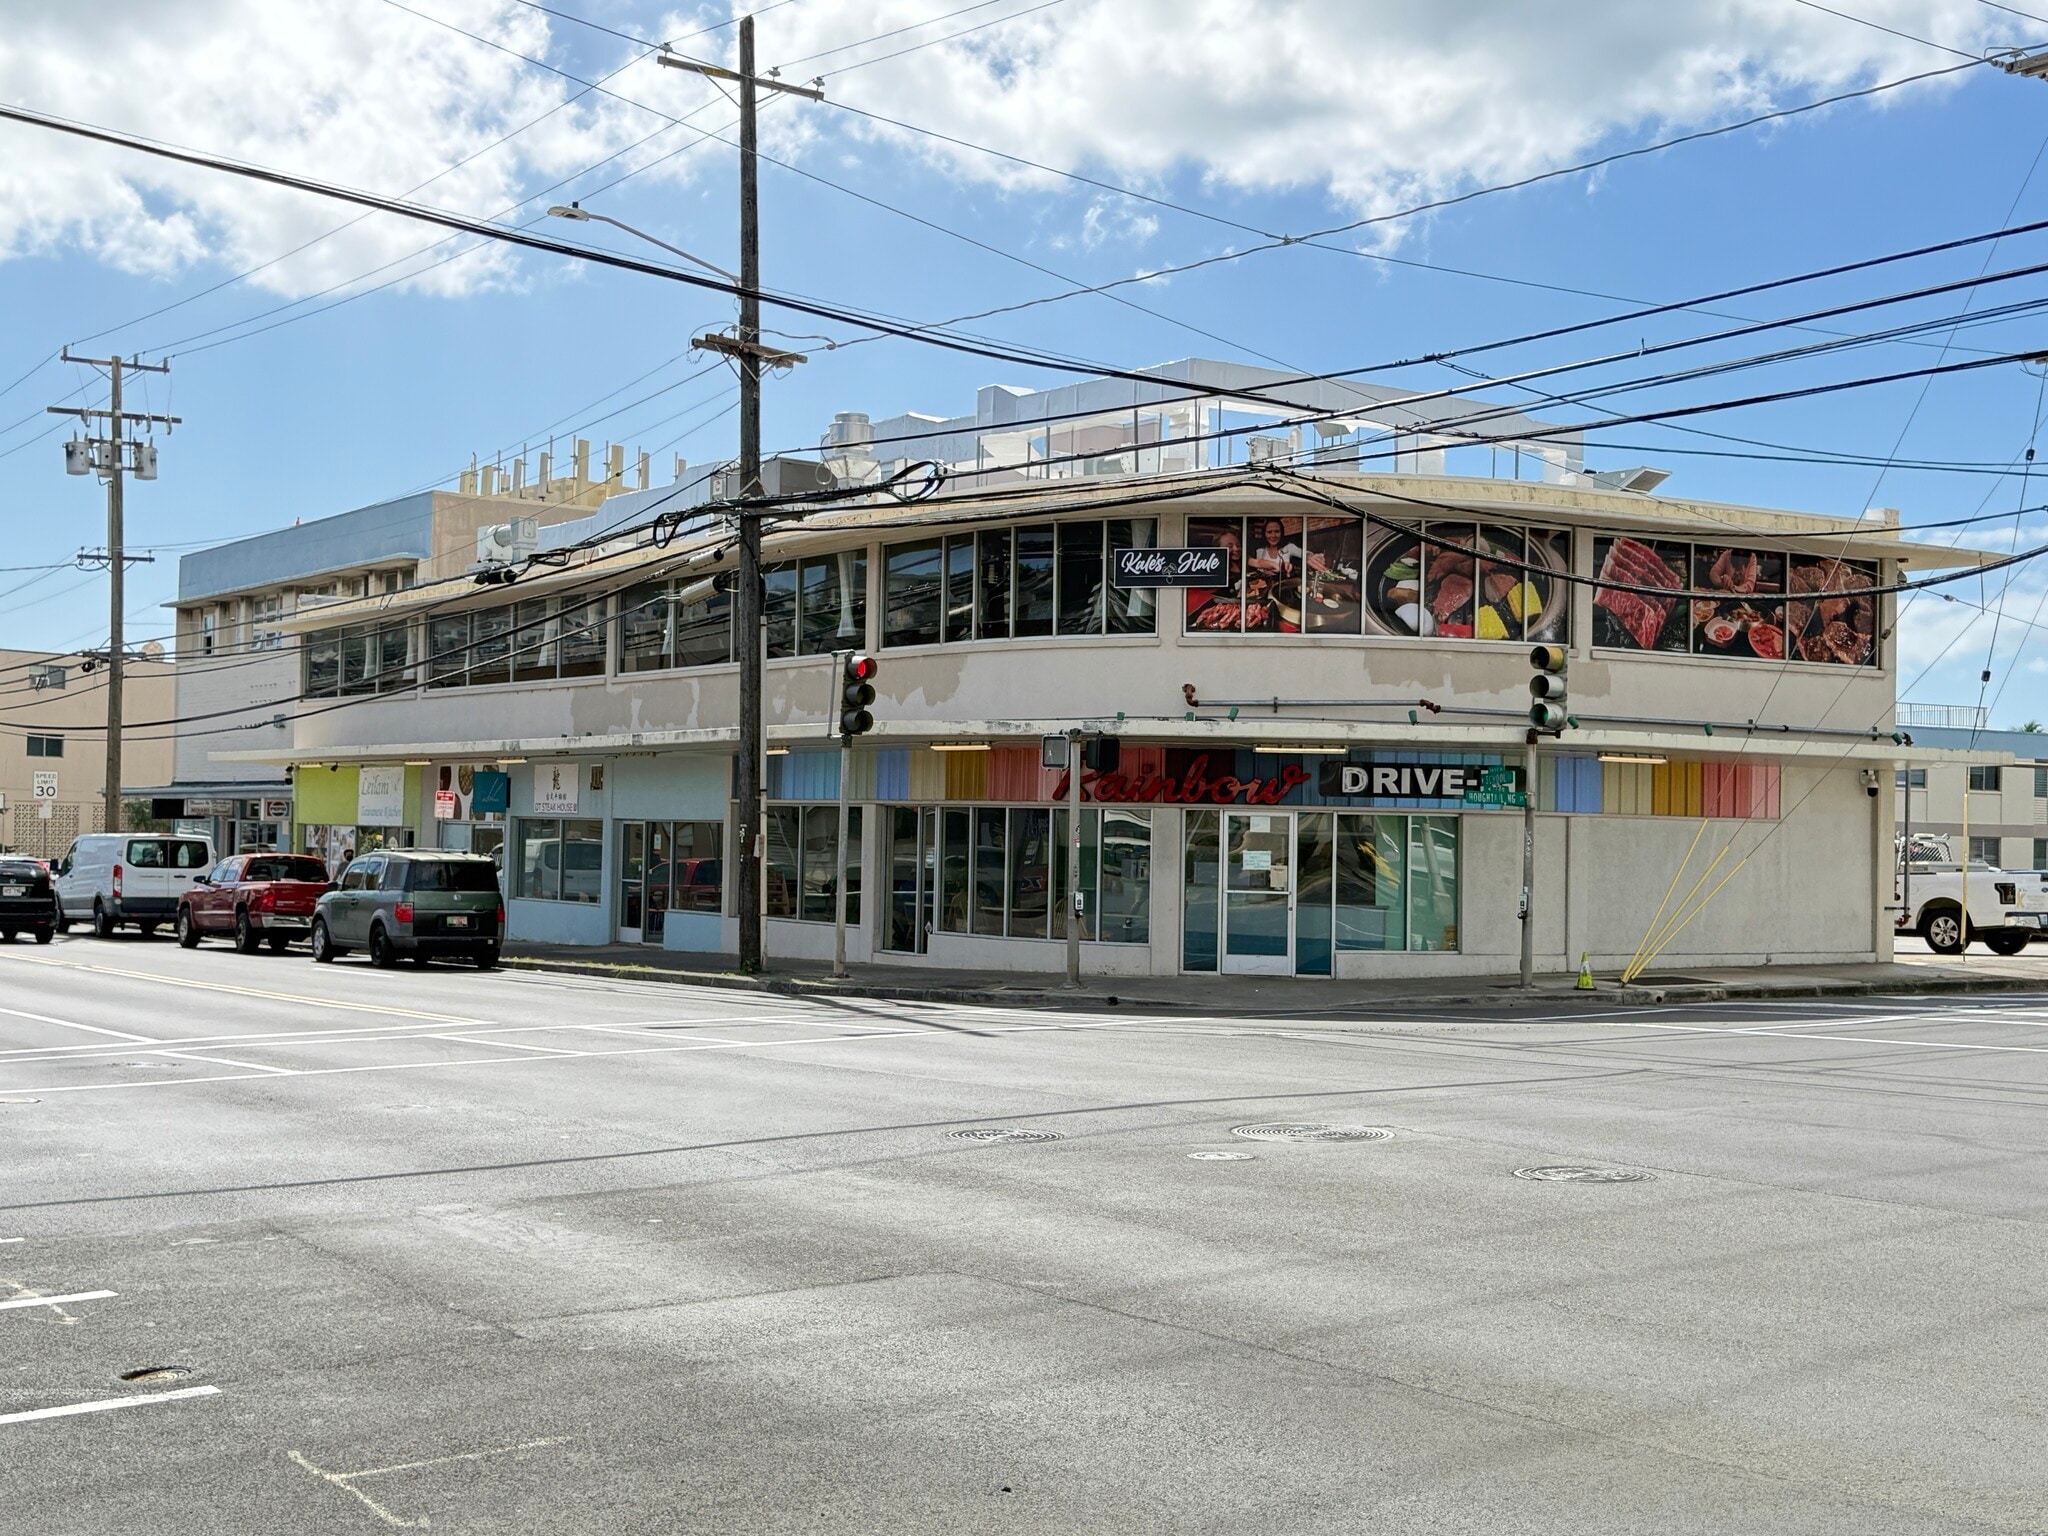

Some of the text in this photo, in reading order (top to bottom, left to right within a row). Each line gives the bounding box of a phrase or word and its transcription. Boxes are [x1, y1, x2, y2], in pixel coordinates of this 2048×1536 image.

[1121, 551, 1220, 575] Kale's Hale
[1052, 754, 1312, 805] Rainbow
[35, 786, 56, 797] 30
[542, 802, 556, 812] STEAK
[557, 802, 573, 812] HOUSE
